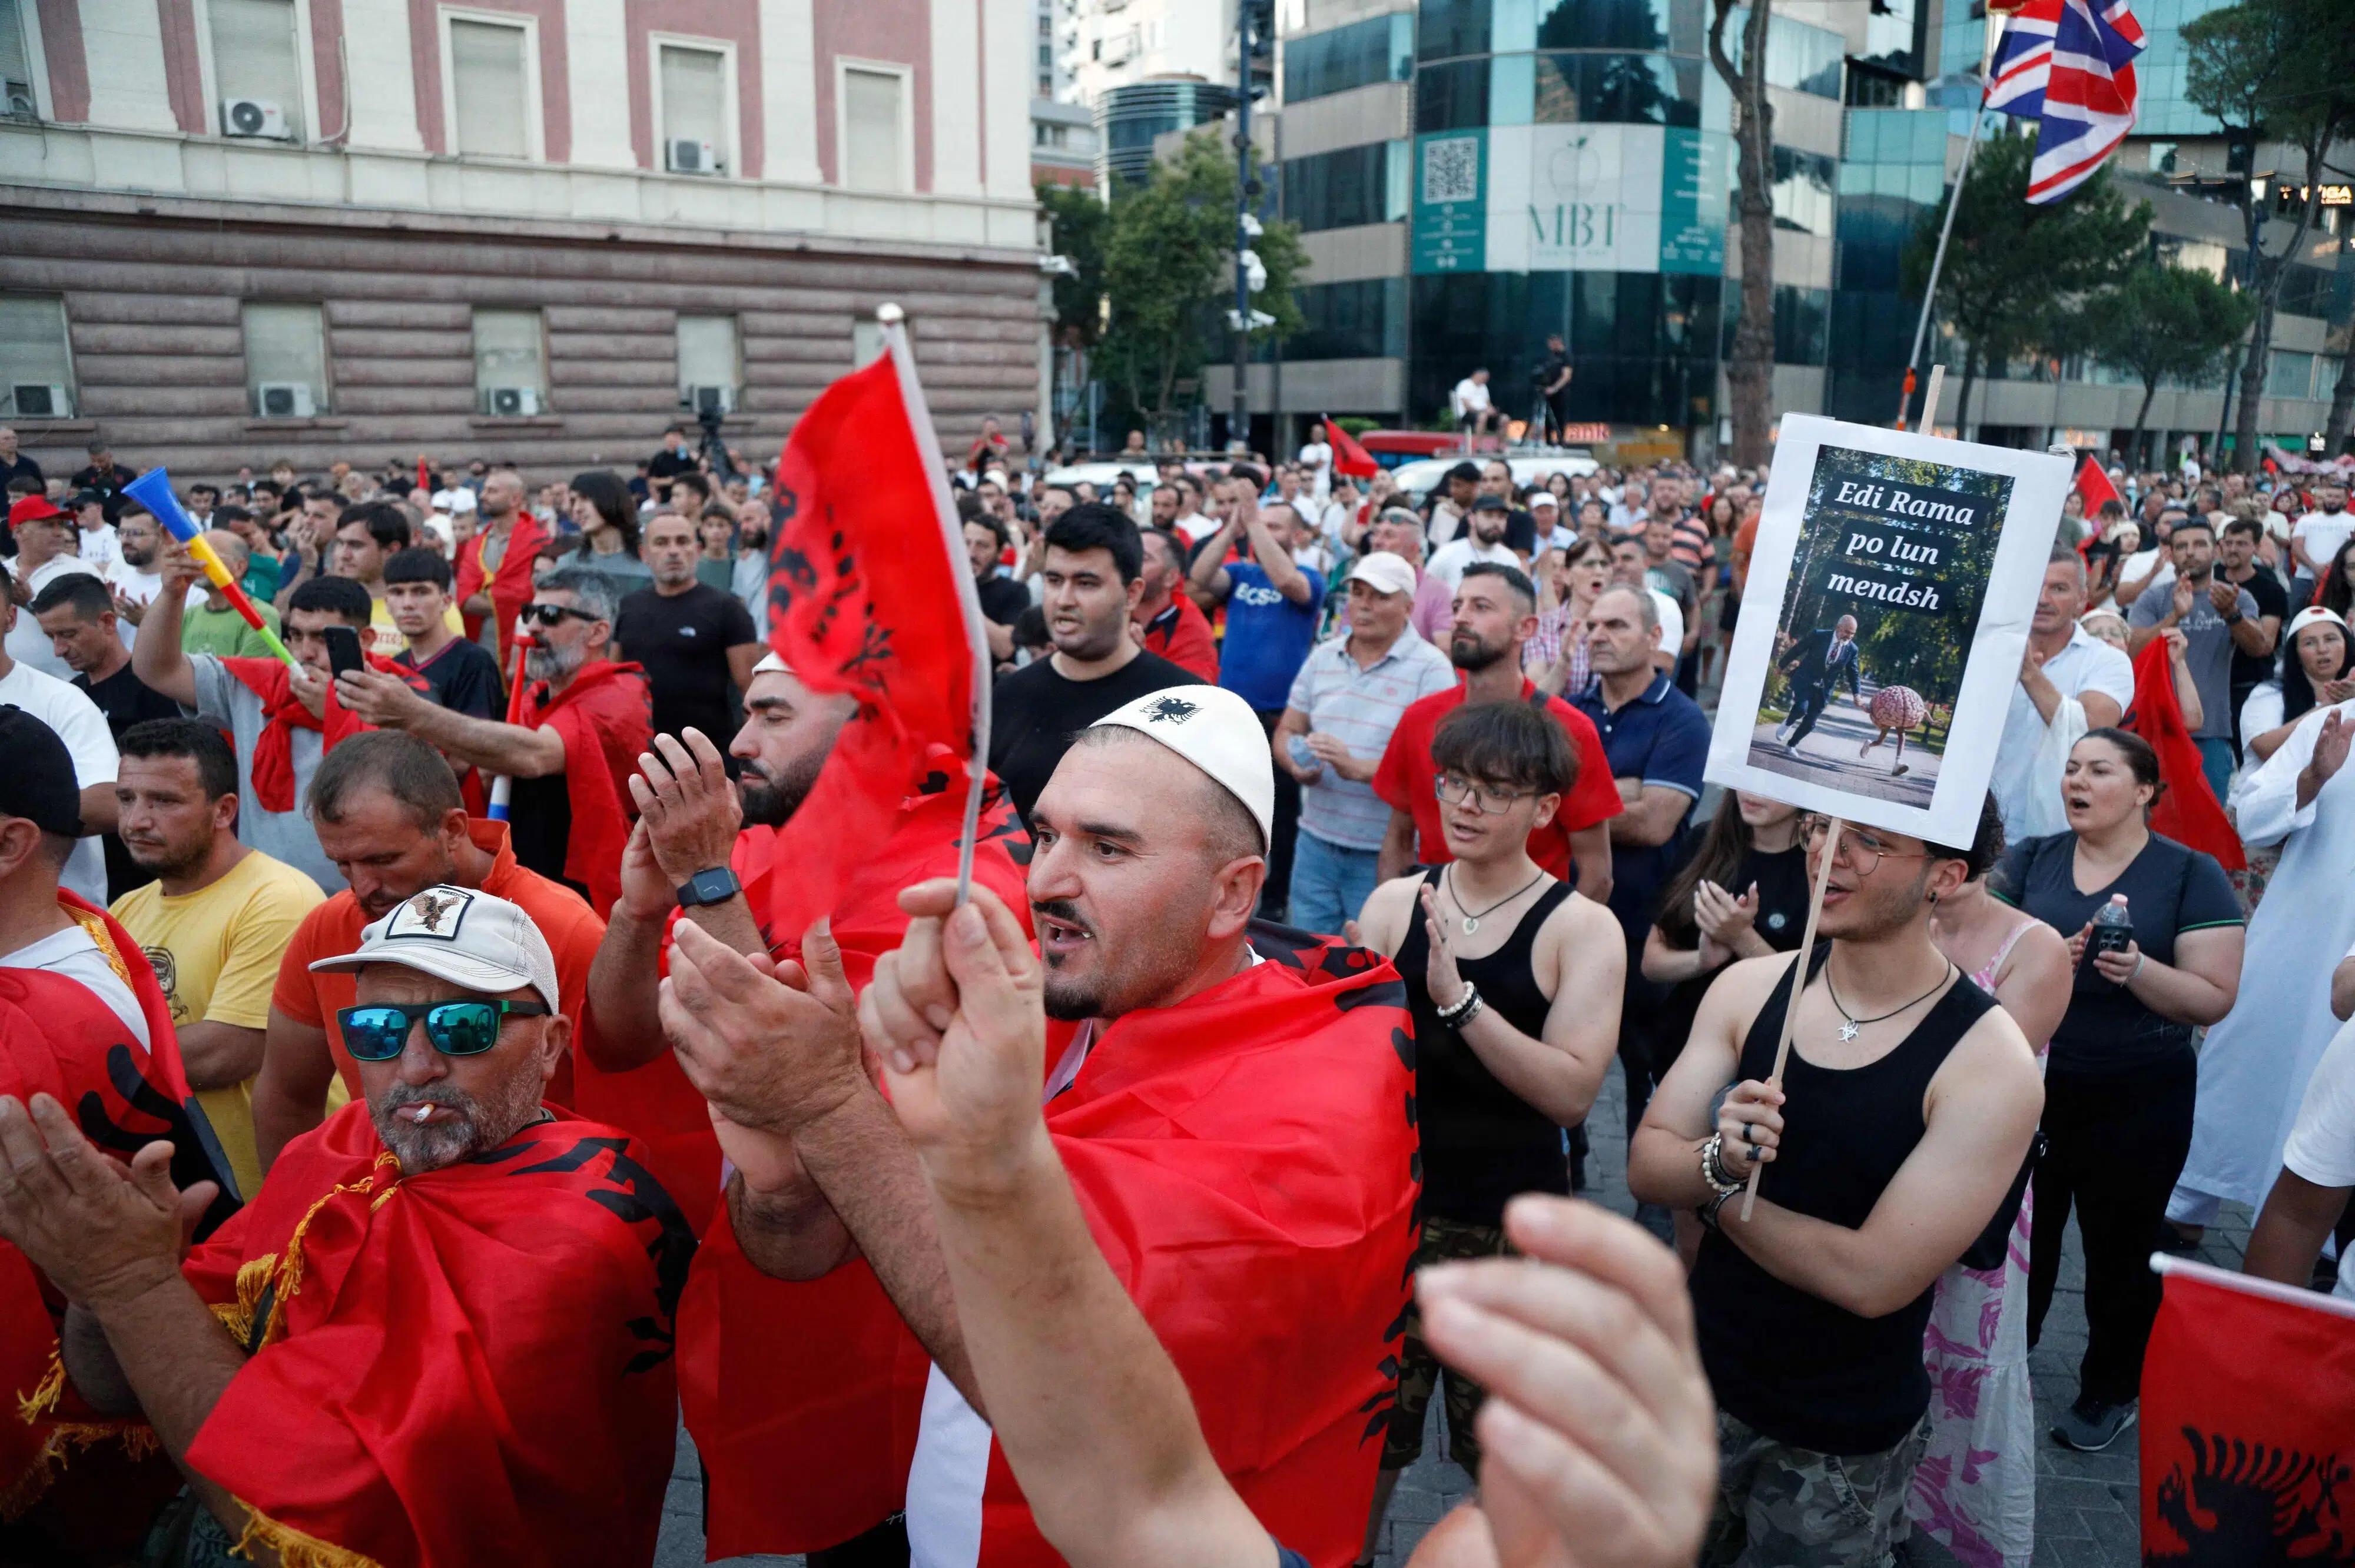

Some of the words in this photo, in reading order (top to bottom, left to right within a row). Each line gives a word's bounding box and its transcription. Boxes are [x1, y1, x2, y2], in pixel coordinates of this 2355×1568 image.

[1835, 481, 1885, 509] Edi
[1886, 490, 1975, 525] Rama
[1845, 533, 1884, 556] po
[1890, 535, 1939, 565] lun
[1827, 573, 1939, 610] mendsh
